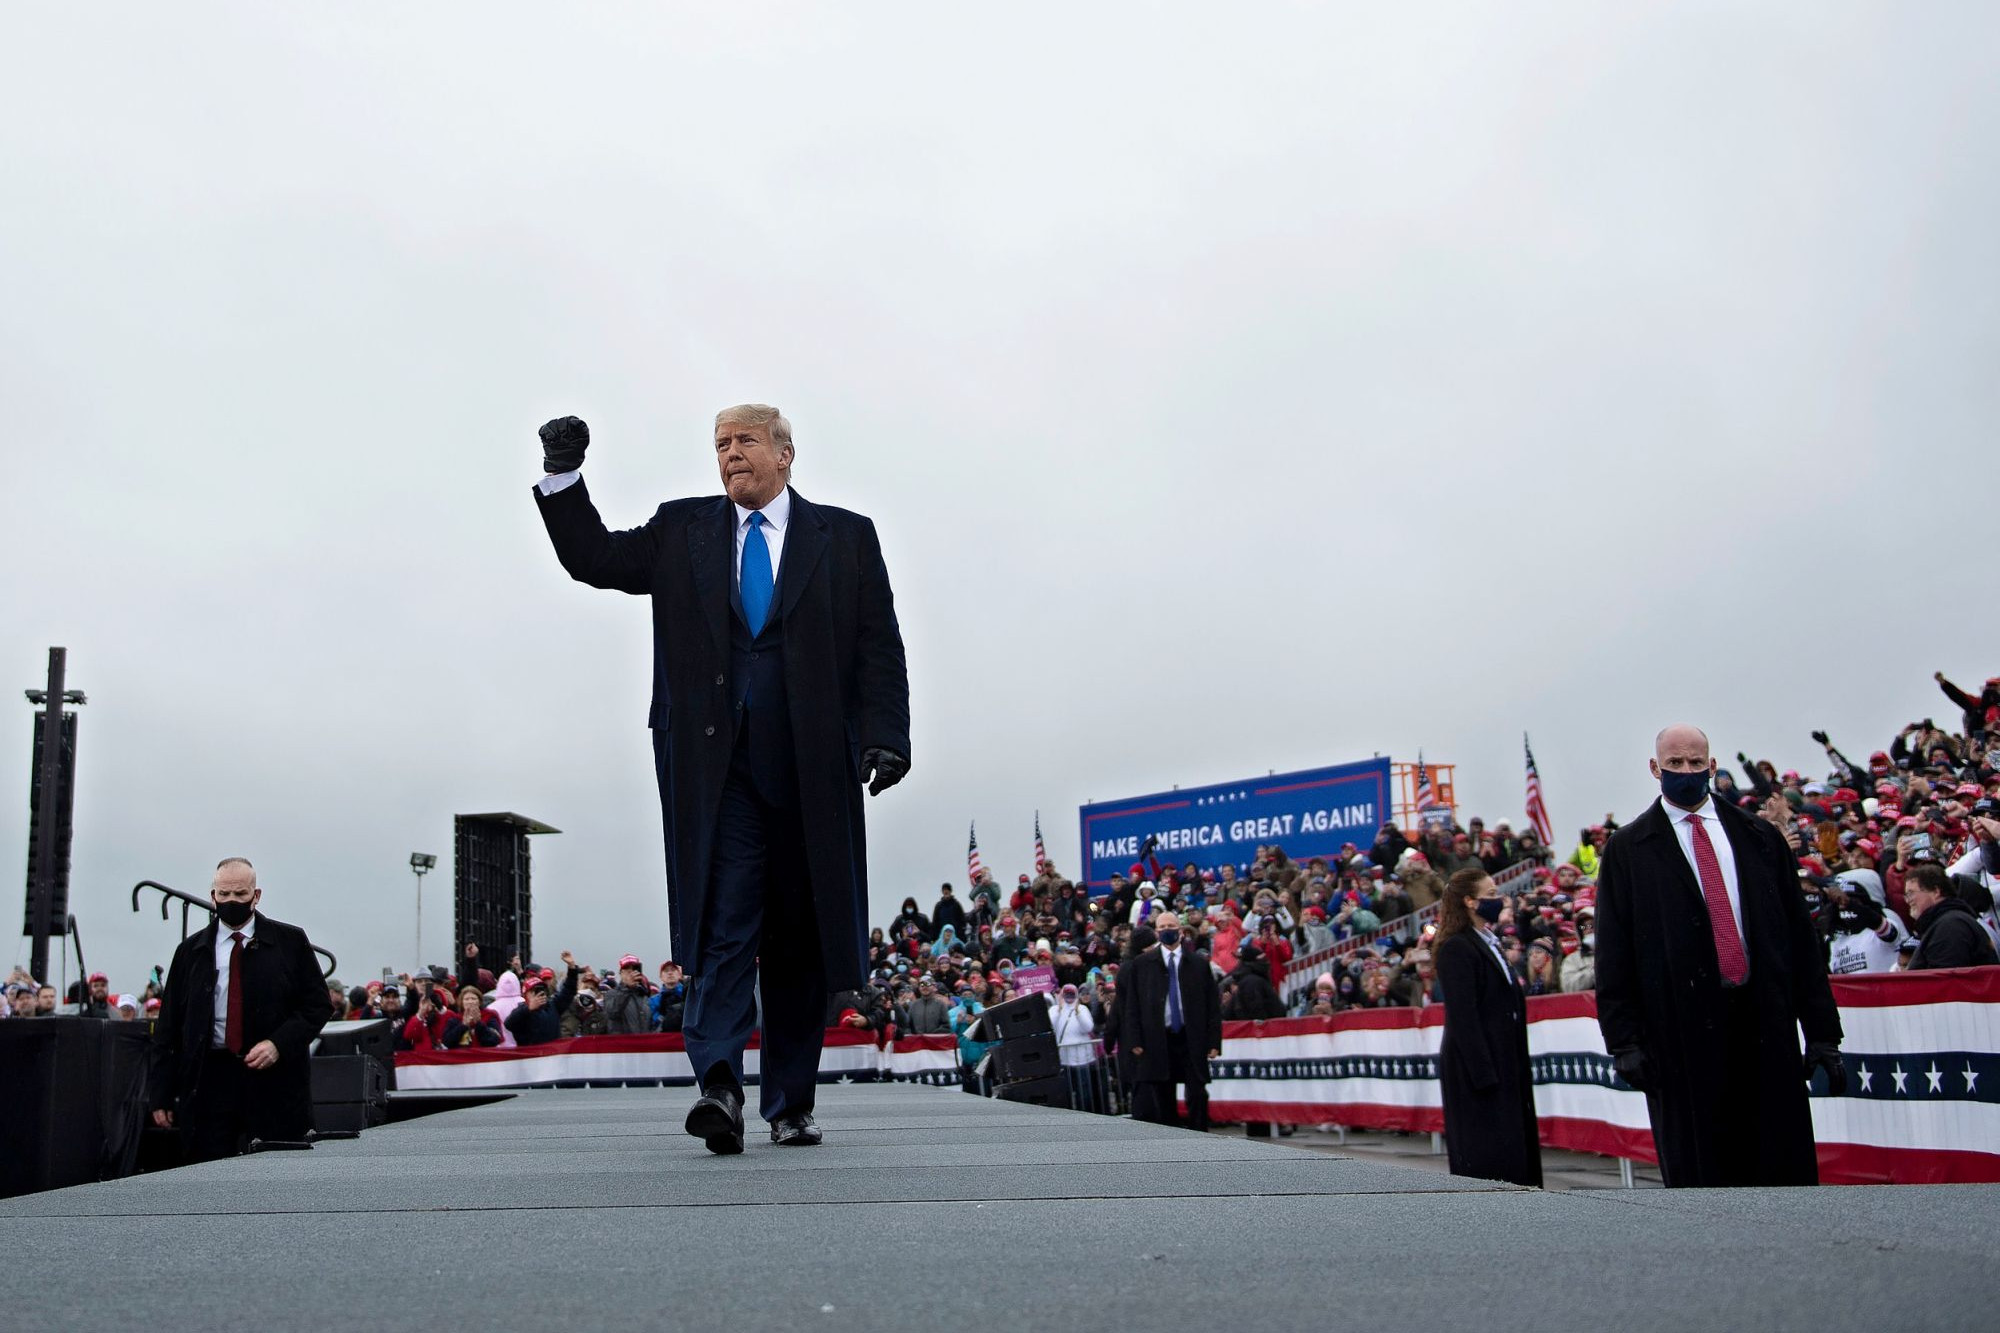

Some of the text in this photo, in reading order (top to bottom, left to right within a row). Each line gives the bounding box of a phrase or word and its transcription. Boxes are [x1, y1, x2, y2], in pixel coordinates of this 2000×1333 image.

[1093, 836, 1138, 859] MAKE
[1230, 814, 1293, 841] GREAT
[1301, 803, 1373, 833] AGAIN!
